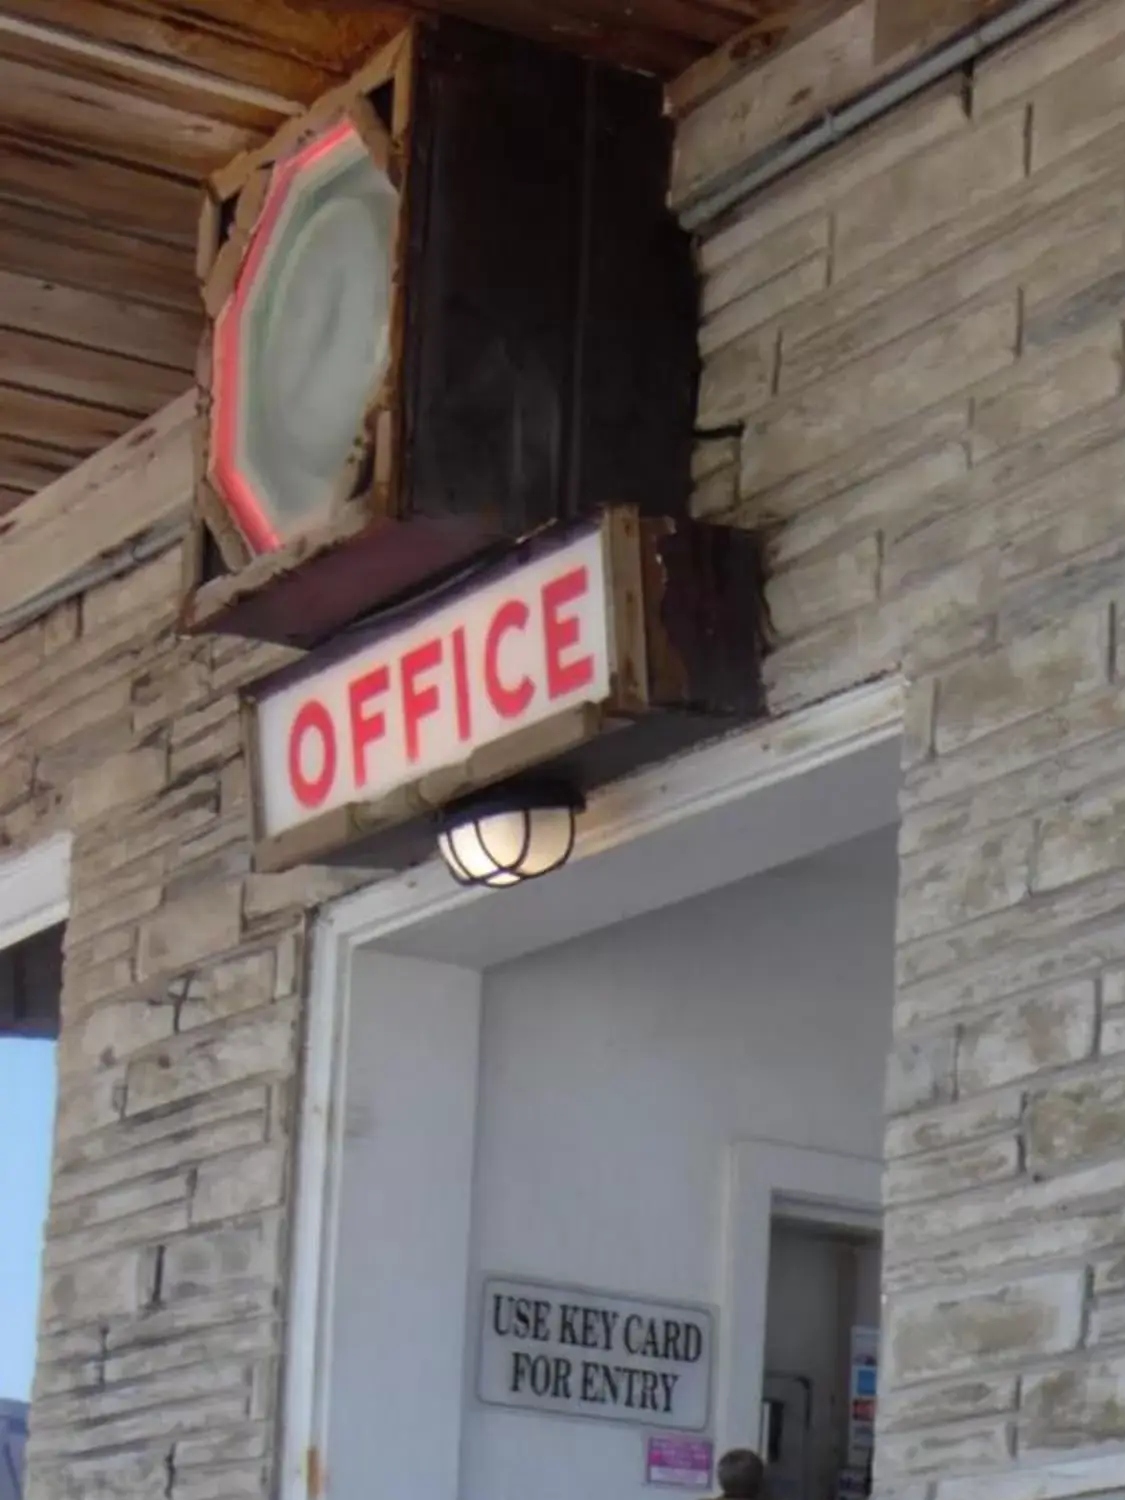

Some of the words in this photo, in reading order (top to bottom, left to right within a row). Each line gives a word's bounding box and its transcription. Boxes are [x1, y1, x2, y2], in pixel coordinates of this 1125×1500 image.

[288, 566, 594, 807] OFFICE
[493, 1294, 551, 1341] USE
[559, 1304, 619, 1350] KEY
[623, 1314, 702, 1363] CARD
[510, 1352, 573, 1399] FOR
[579, 1360, 680, 1413] ENTRY
